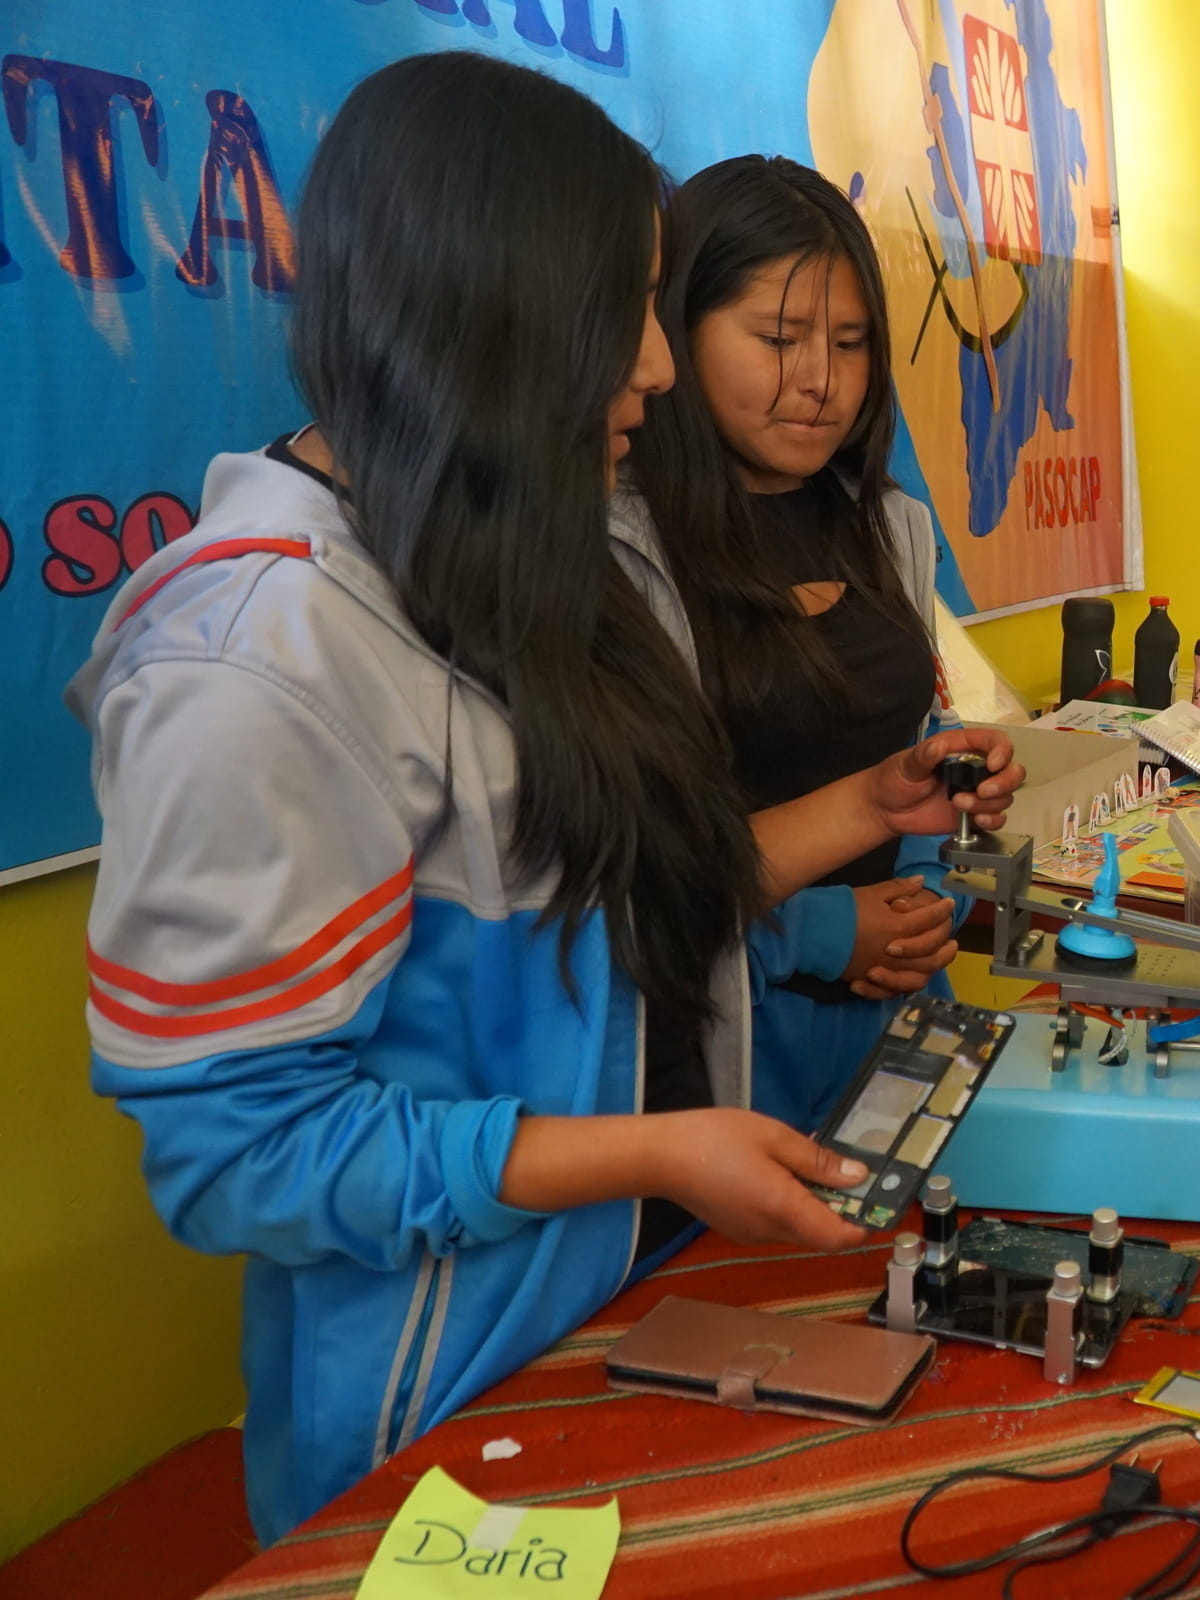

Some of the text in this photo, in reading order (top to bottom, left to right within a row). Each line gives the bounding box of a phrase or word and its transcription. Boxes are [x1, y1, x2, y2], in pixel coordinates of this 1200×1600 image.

[1024, 456, 1101, 531] PASOCAP
[42, 491, 201, 598] SO
[394, 1519, 568, 1582] Daria
